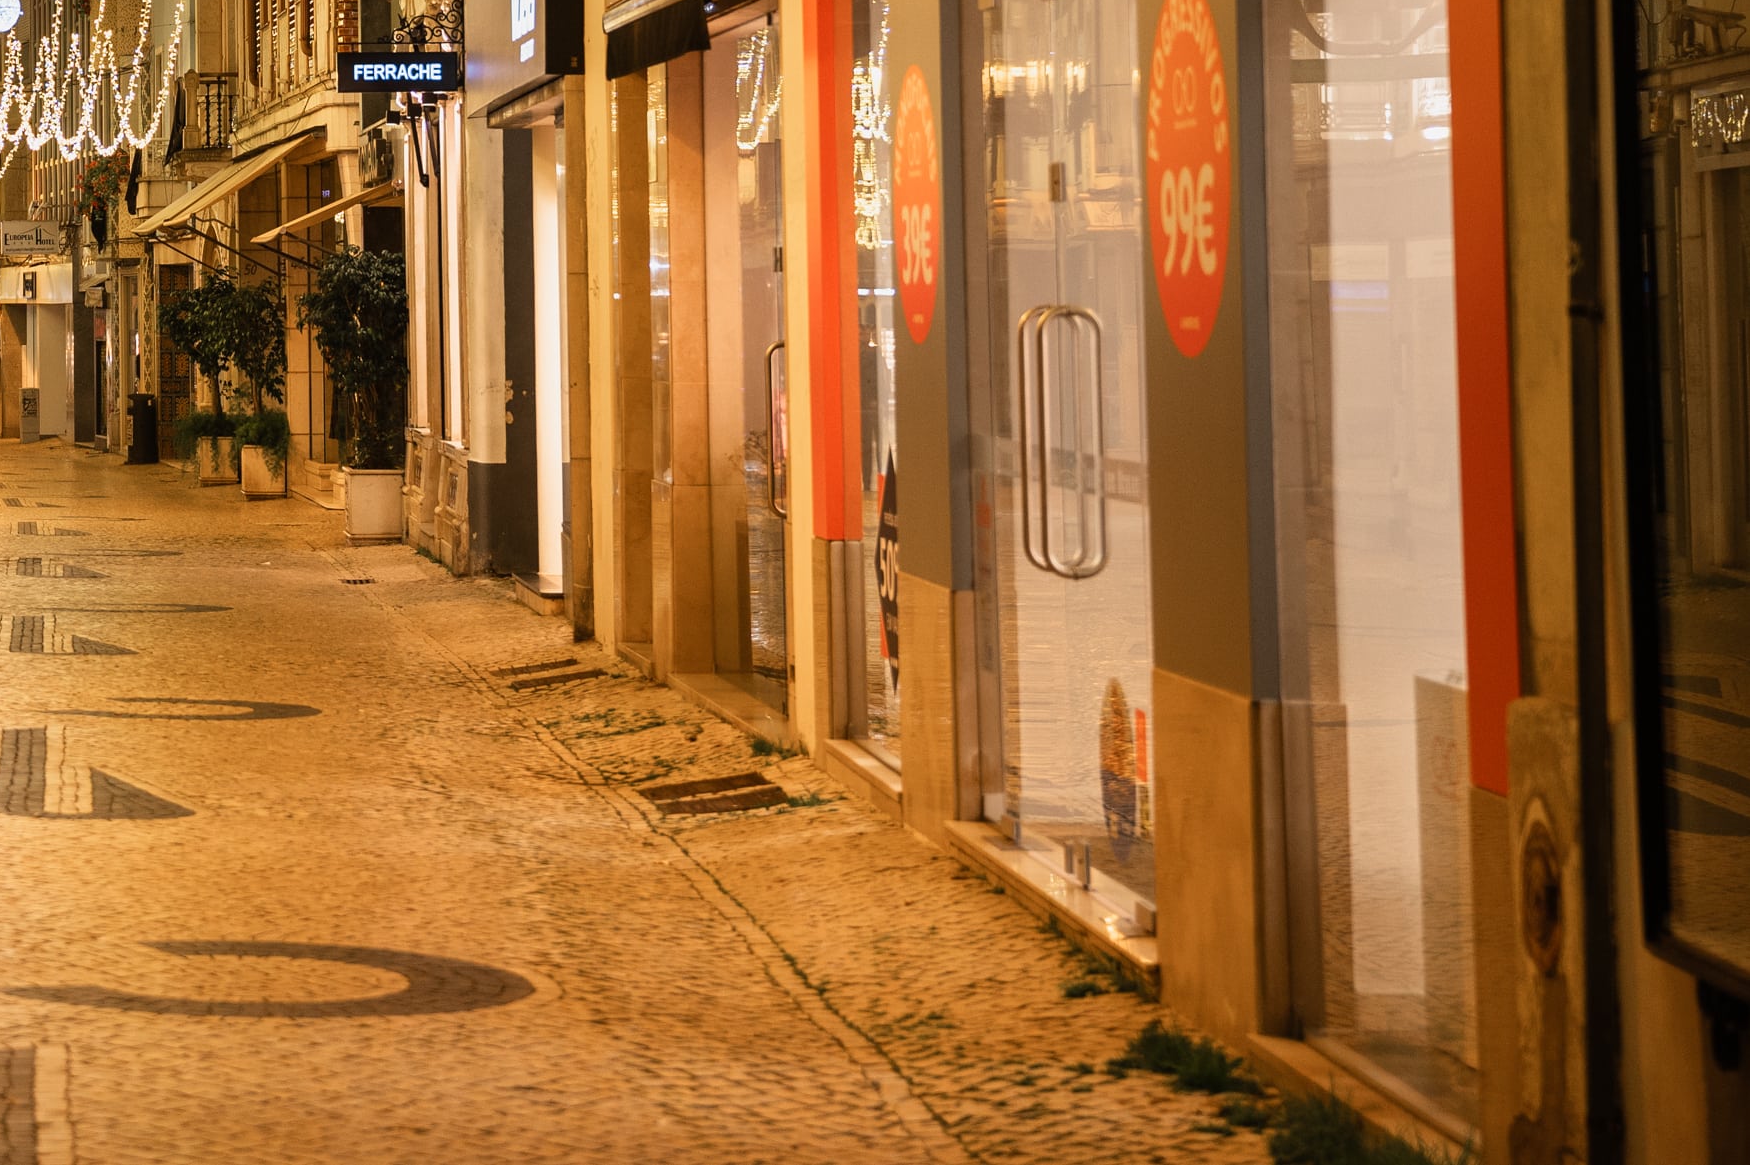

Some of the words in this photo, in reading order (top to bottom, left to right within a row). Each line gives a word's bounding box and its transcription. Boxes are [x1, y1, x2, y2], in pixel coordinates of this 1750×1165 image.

[353, 63, 443, 81] FERRACHE
[35, 227, 55, 246] HOTEL
[901, 204, 933, 285] 39€
[1160, 163, 1217, 276] 99€
